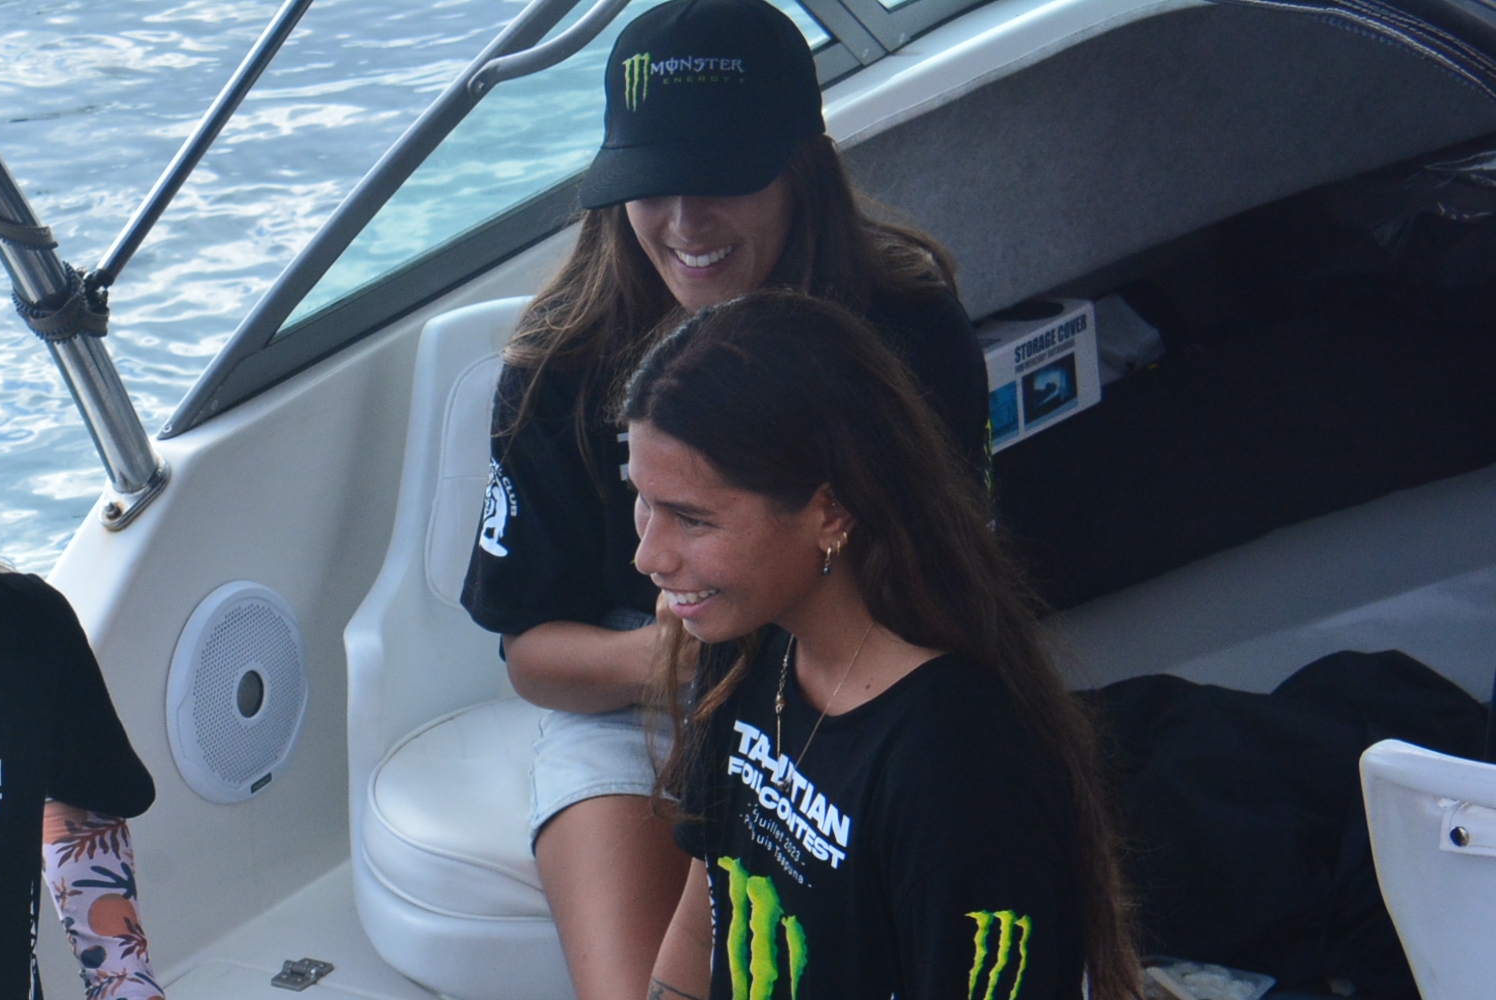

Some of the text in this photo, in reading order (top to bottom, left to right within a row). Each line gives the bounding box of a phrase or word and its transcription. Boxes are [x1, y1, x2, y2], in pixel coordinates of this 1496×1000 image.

[650, 56, 745, 75] MONSTER
[1015, 314, 1087, 363] STORAGE COVER
[733, 720, 851, 847] TAHITIAN
[727, 755, 846, 869] FOIL CONTEST
[784, 838, 801, 862] 2023
